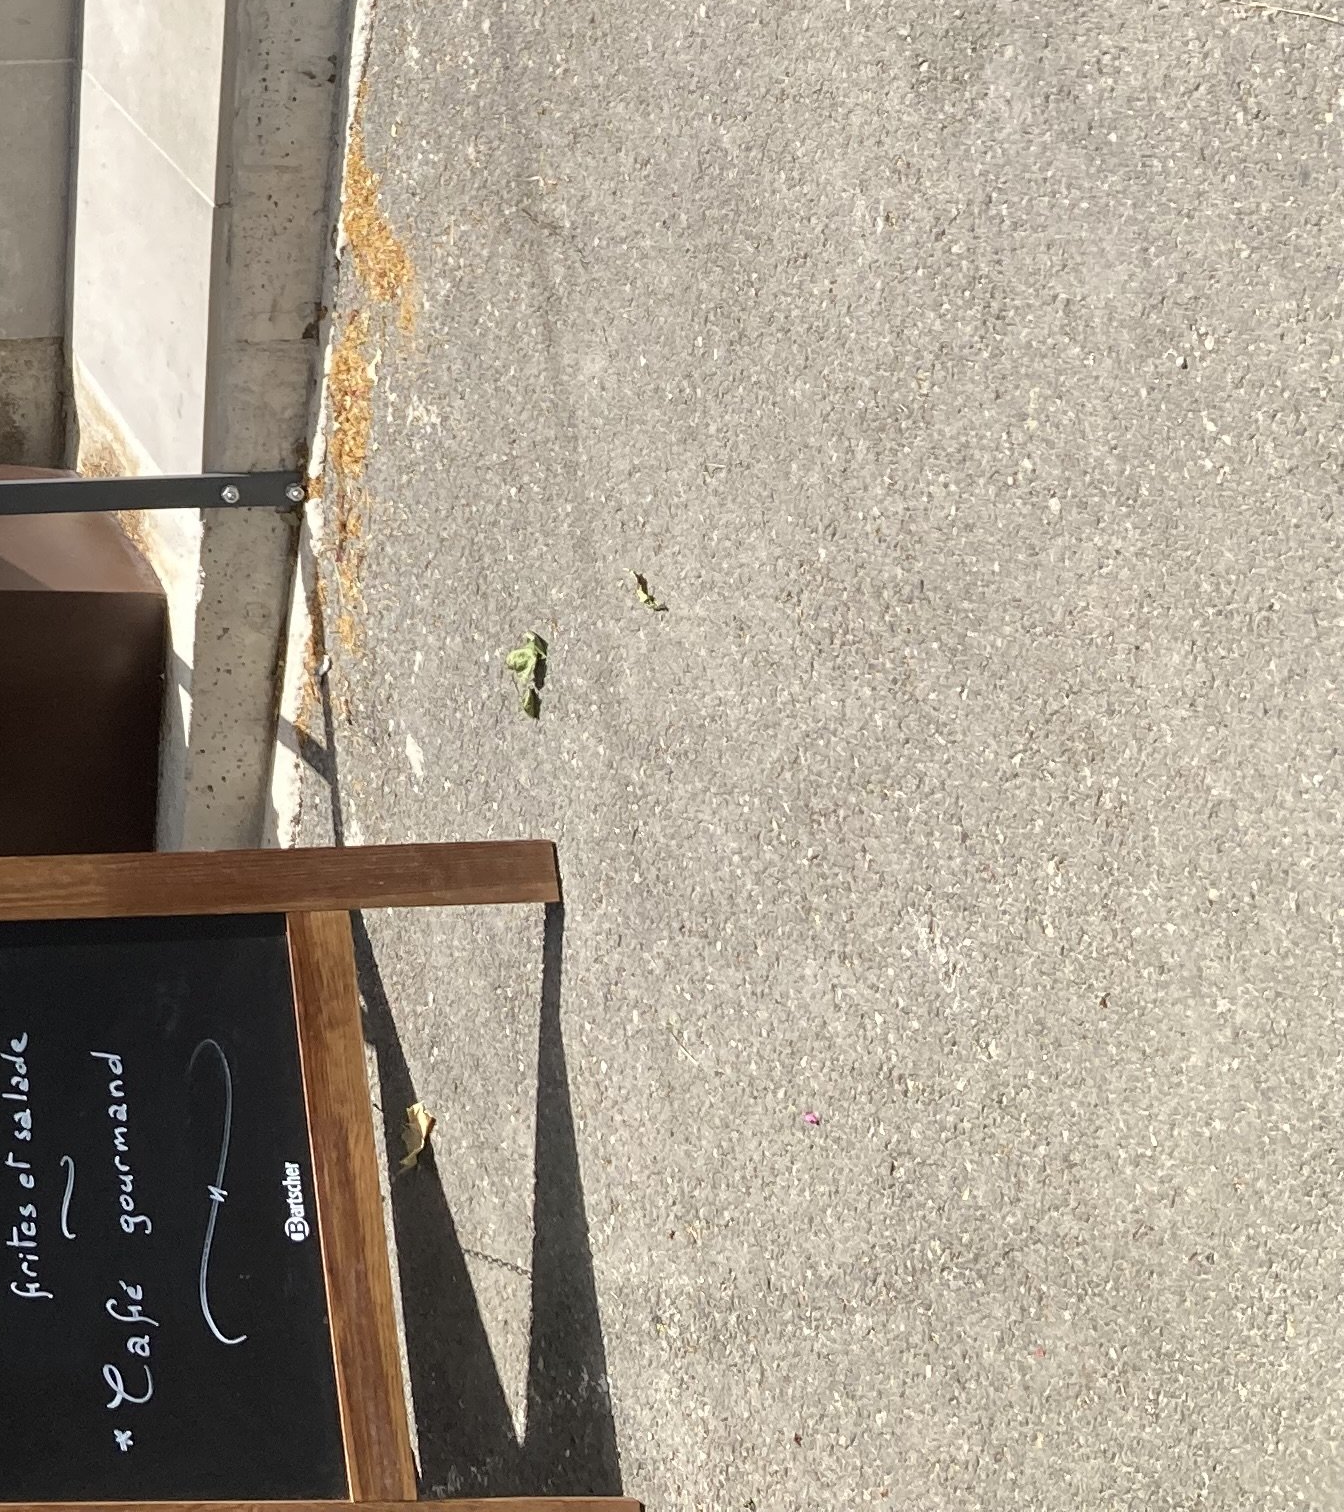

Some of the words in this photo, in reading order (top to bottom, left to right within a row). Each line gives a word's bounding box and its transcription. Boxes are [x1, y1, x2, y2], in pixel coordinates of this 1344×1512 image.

[0, 1032, 32, 1141] salade
[4, 1152, 35, 1189] et
[90, 1051, 152, 1235] gourmand
[5, 1203, 54, 1299] frites
[282, 1161, 310, 1241] Bartscher
[103, 1280, 159, 1409] Café
